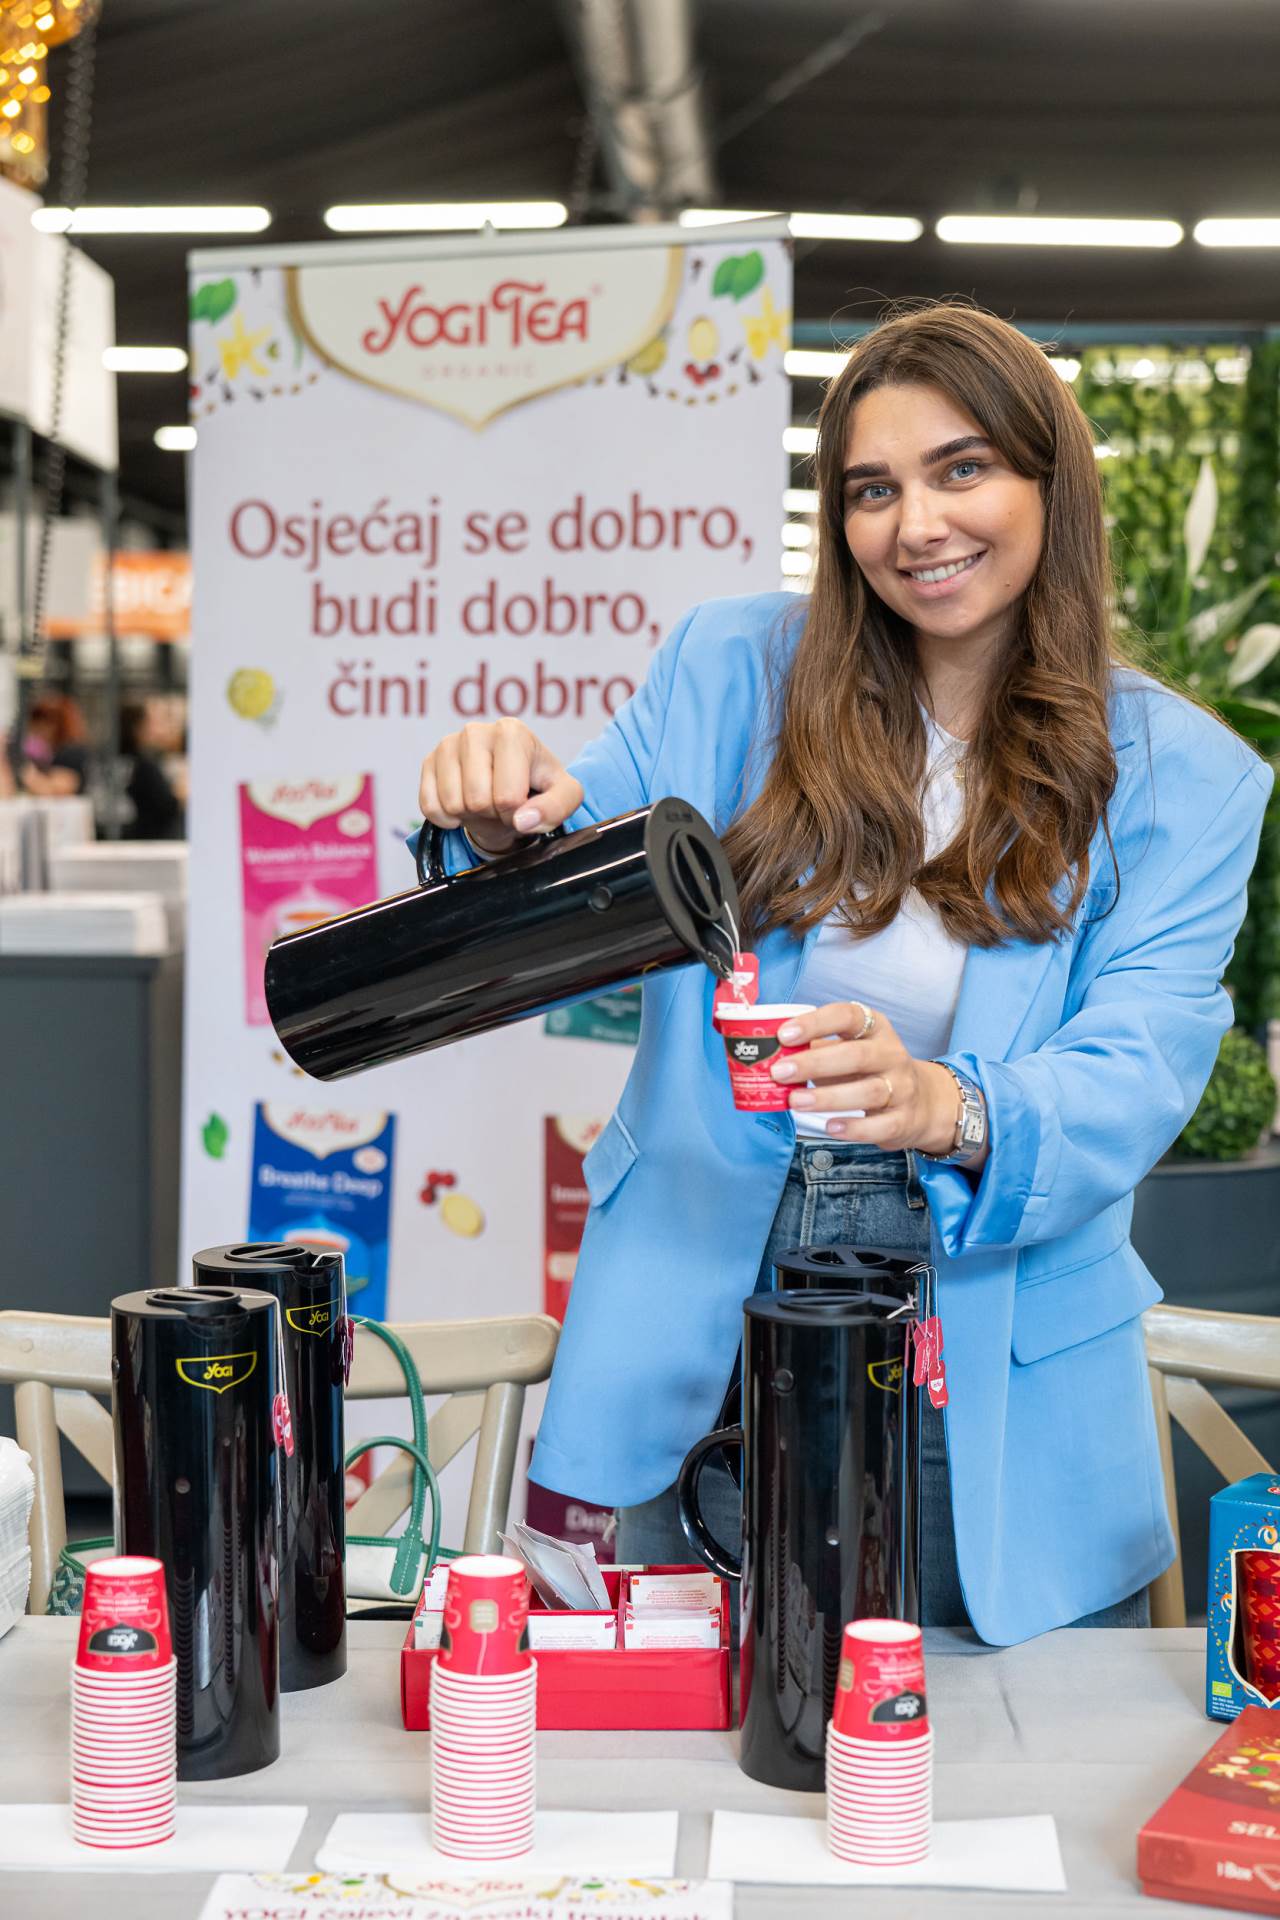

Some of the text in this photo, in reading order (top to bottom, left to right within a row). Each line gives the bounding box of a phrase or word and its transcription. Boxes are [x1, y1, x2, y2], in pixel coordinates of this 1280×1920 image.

[362, 278, 589, 354] YOGI TEA
[228, 490, 755, 572] Osjećaj se dobro,
[311, 575, 660, 648] budi dobro,
[327, 656, 429, 718] čini
[258, 1163, 384, 1199] Breathe Deep
[308, 1310, 329, 1326] YOGI
[203, 1362, 233, 1380] YOGI
